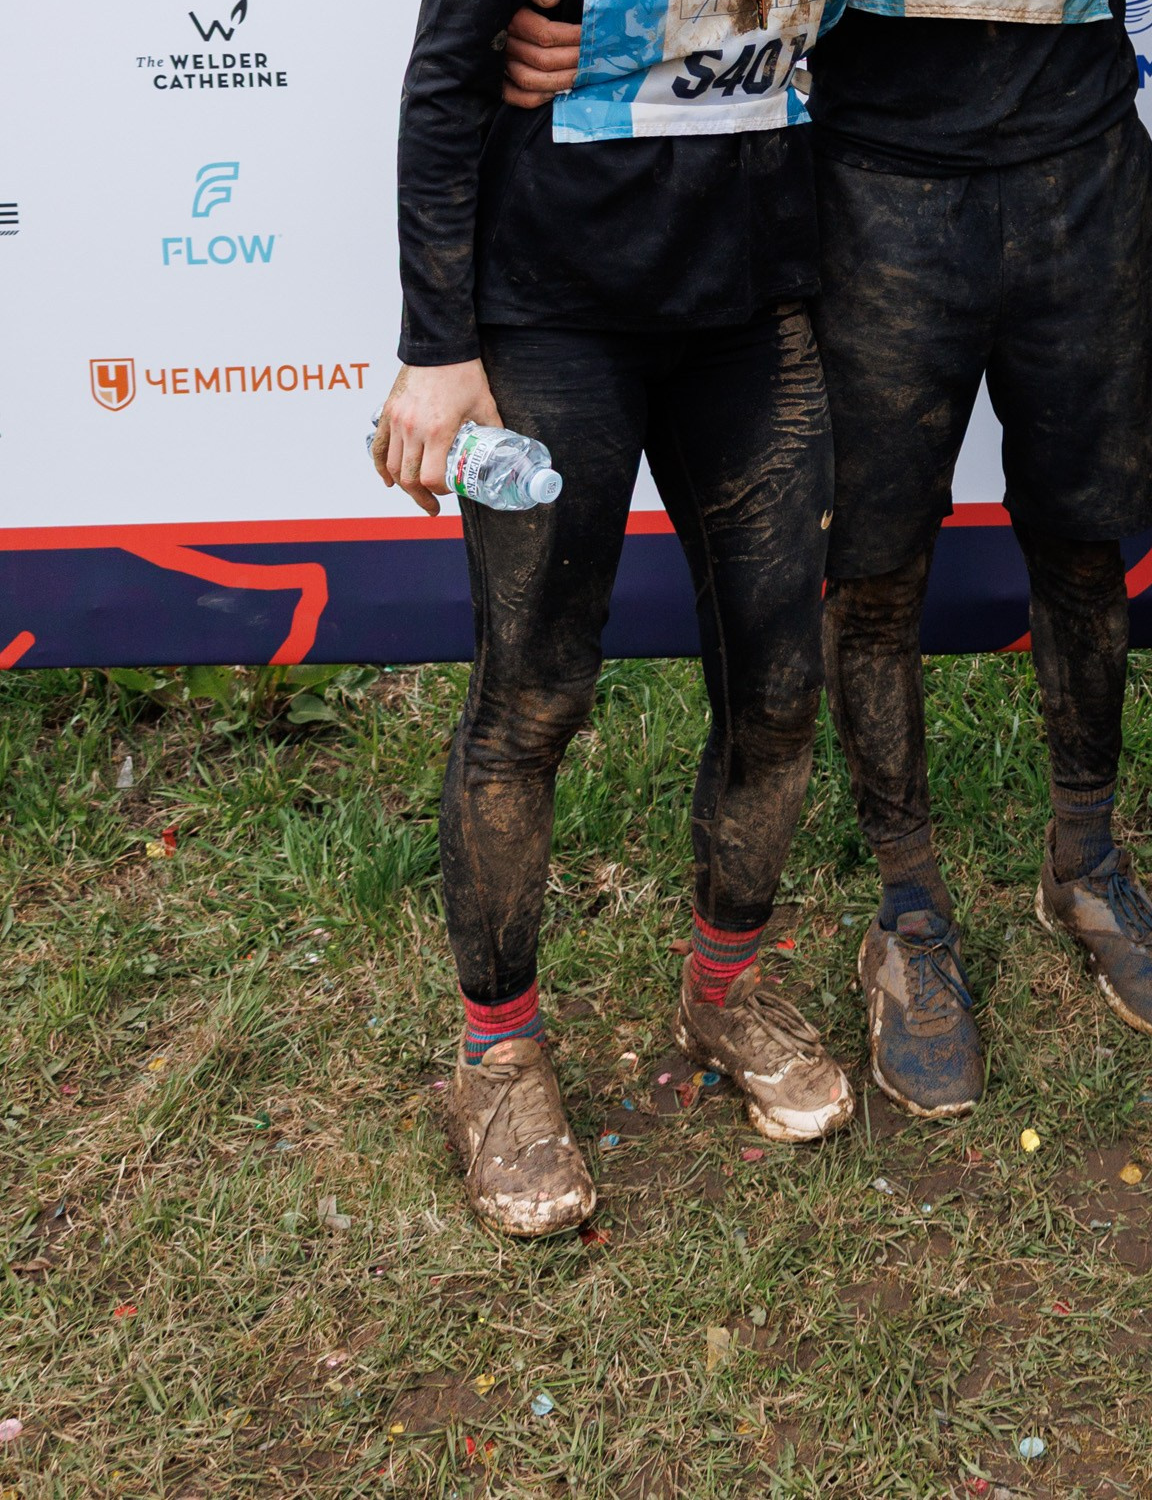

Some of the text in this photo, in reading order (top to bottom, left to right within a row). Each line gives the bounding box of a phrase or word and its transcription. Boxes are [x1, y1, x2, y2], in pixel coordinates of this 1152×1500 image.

[136, 54, 268, 70] The WELDER
[671, 33, 808, 100] 5401
[153, 72, 288, 89] CATHERINE
[162, 236, 275, 266] FLOW
[145, 363, 370, 395] ЧЕМПИОНАТ
